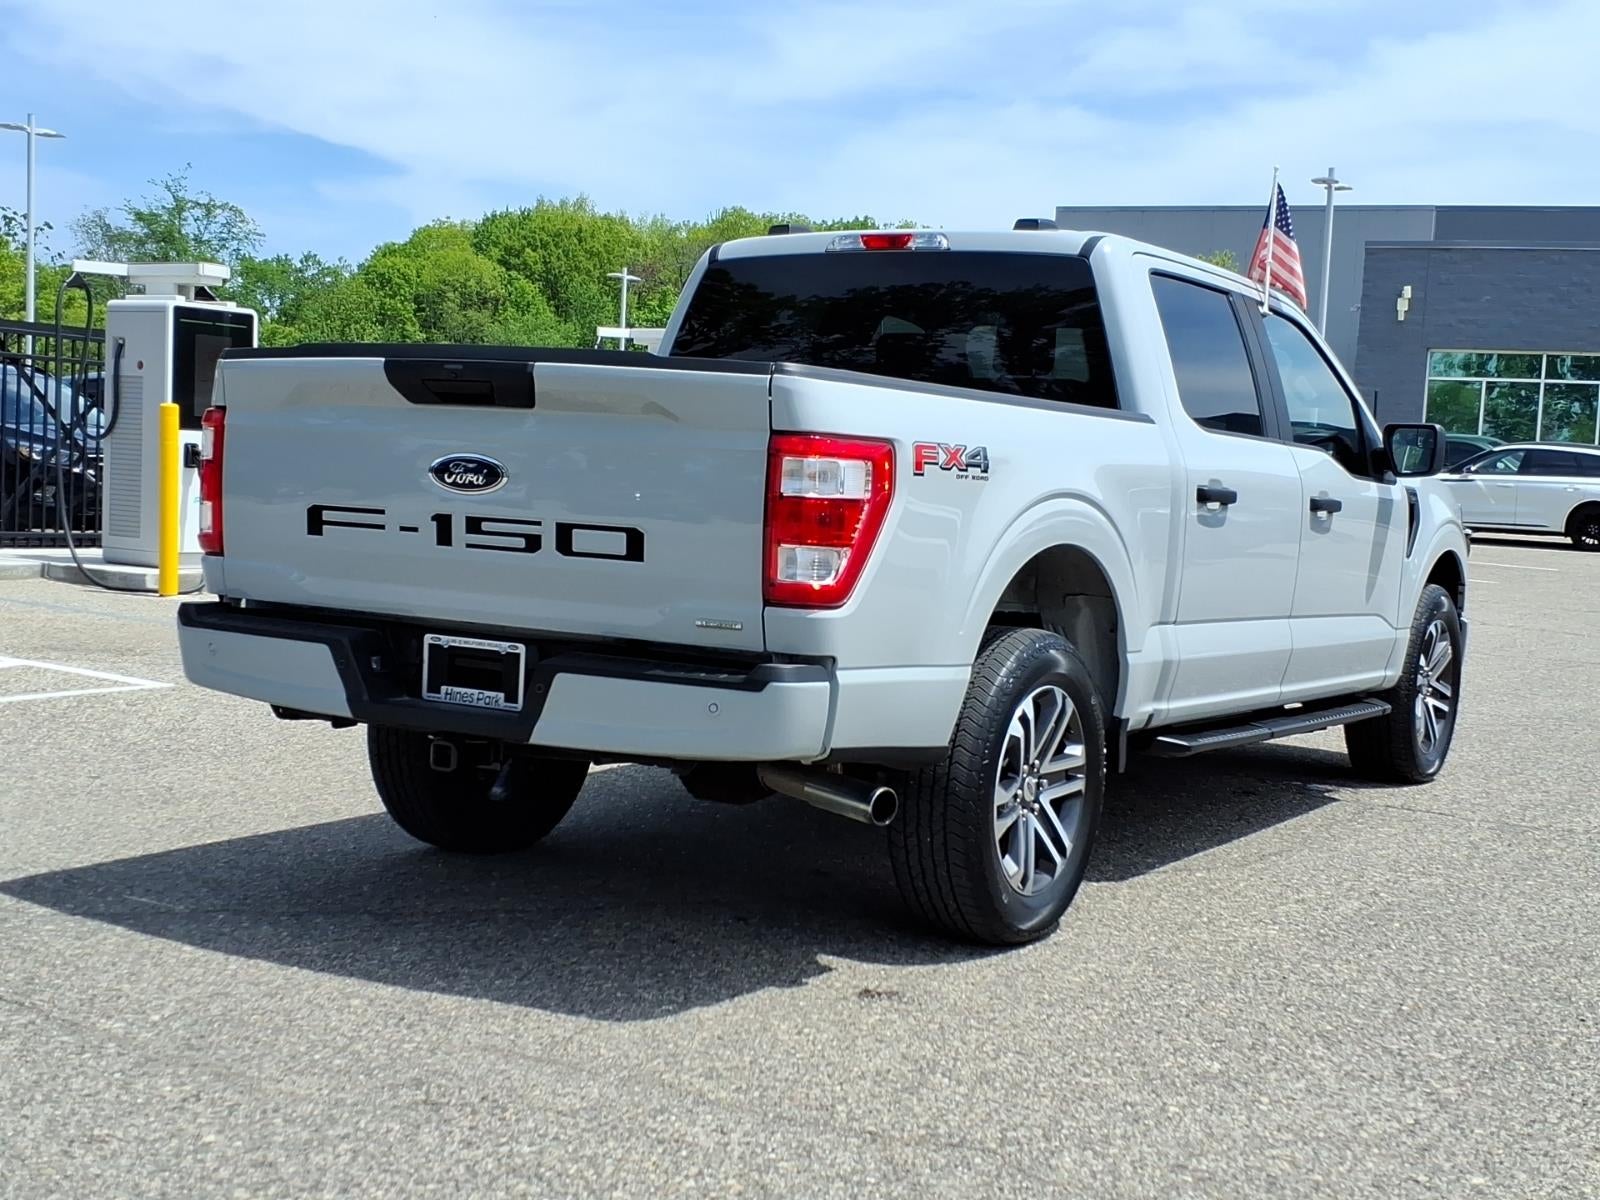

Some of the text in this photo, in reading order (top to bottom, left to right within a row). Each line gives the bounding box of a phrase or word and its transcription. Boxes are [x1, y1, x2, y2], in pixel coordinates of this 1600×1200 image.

[444, 461, 488, 485] Ford
[912, 441, 989, 476] FX4
[307, 504, 645, 562] F-150
[445, 687, 501, 706] Hines Park
